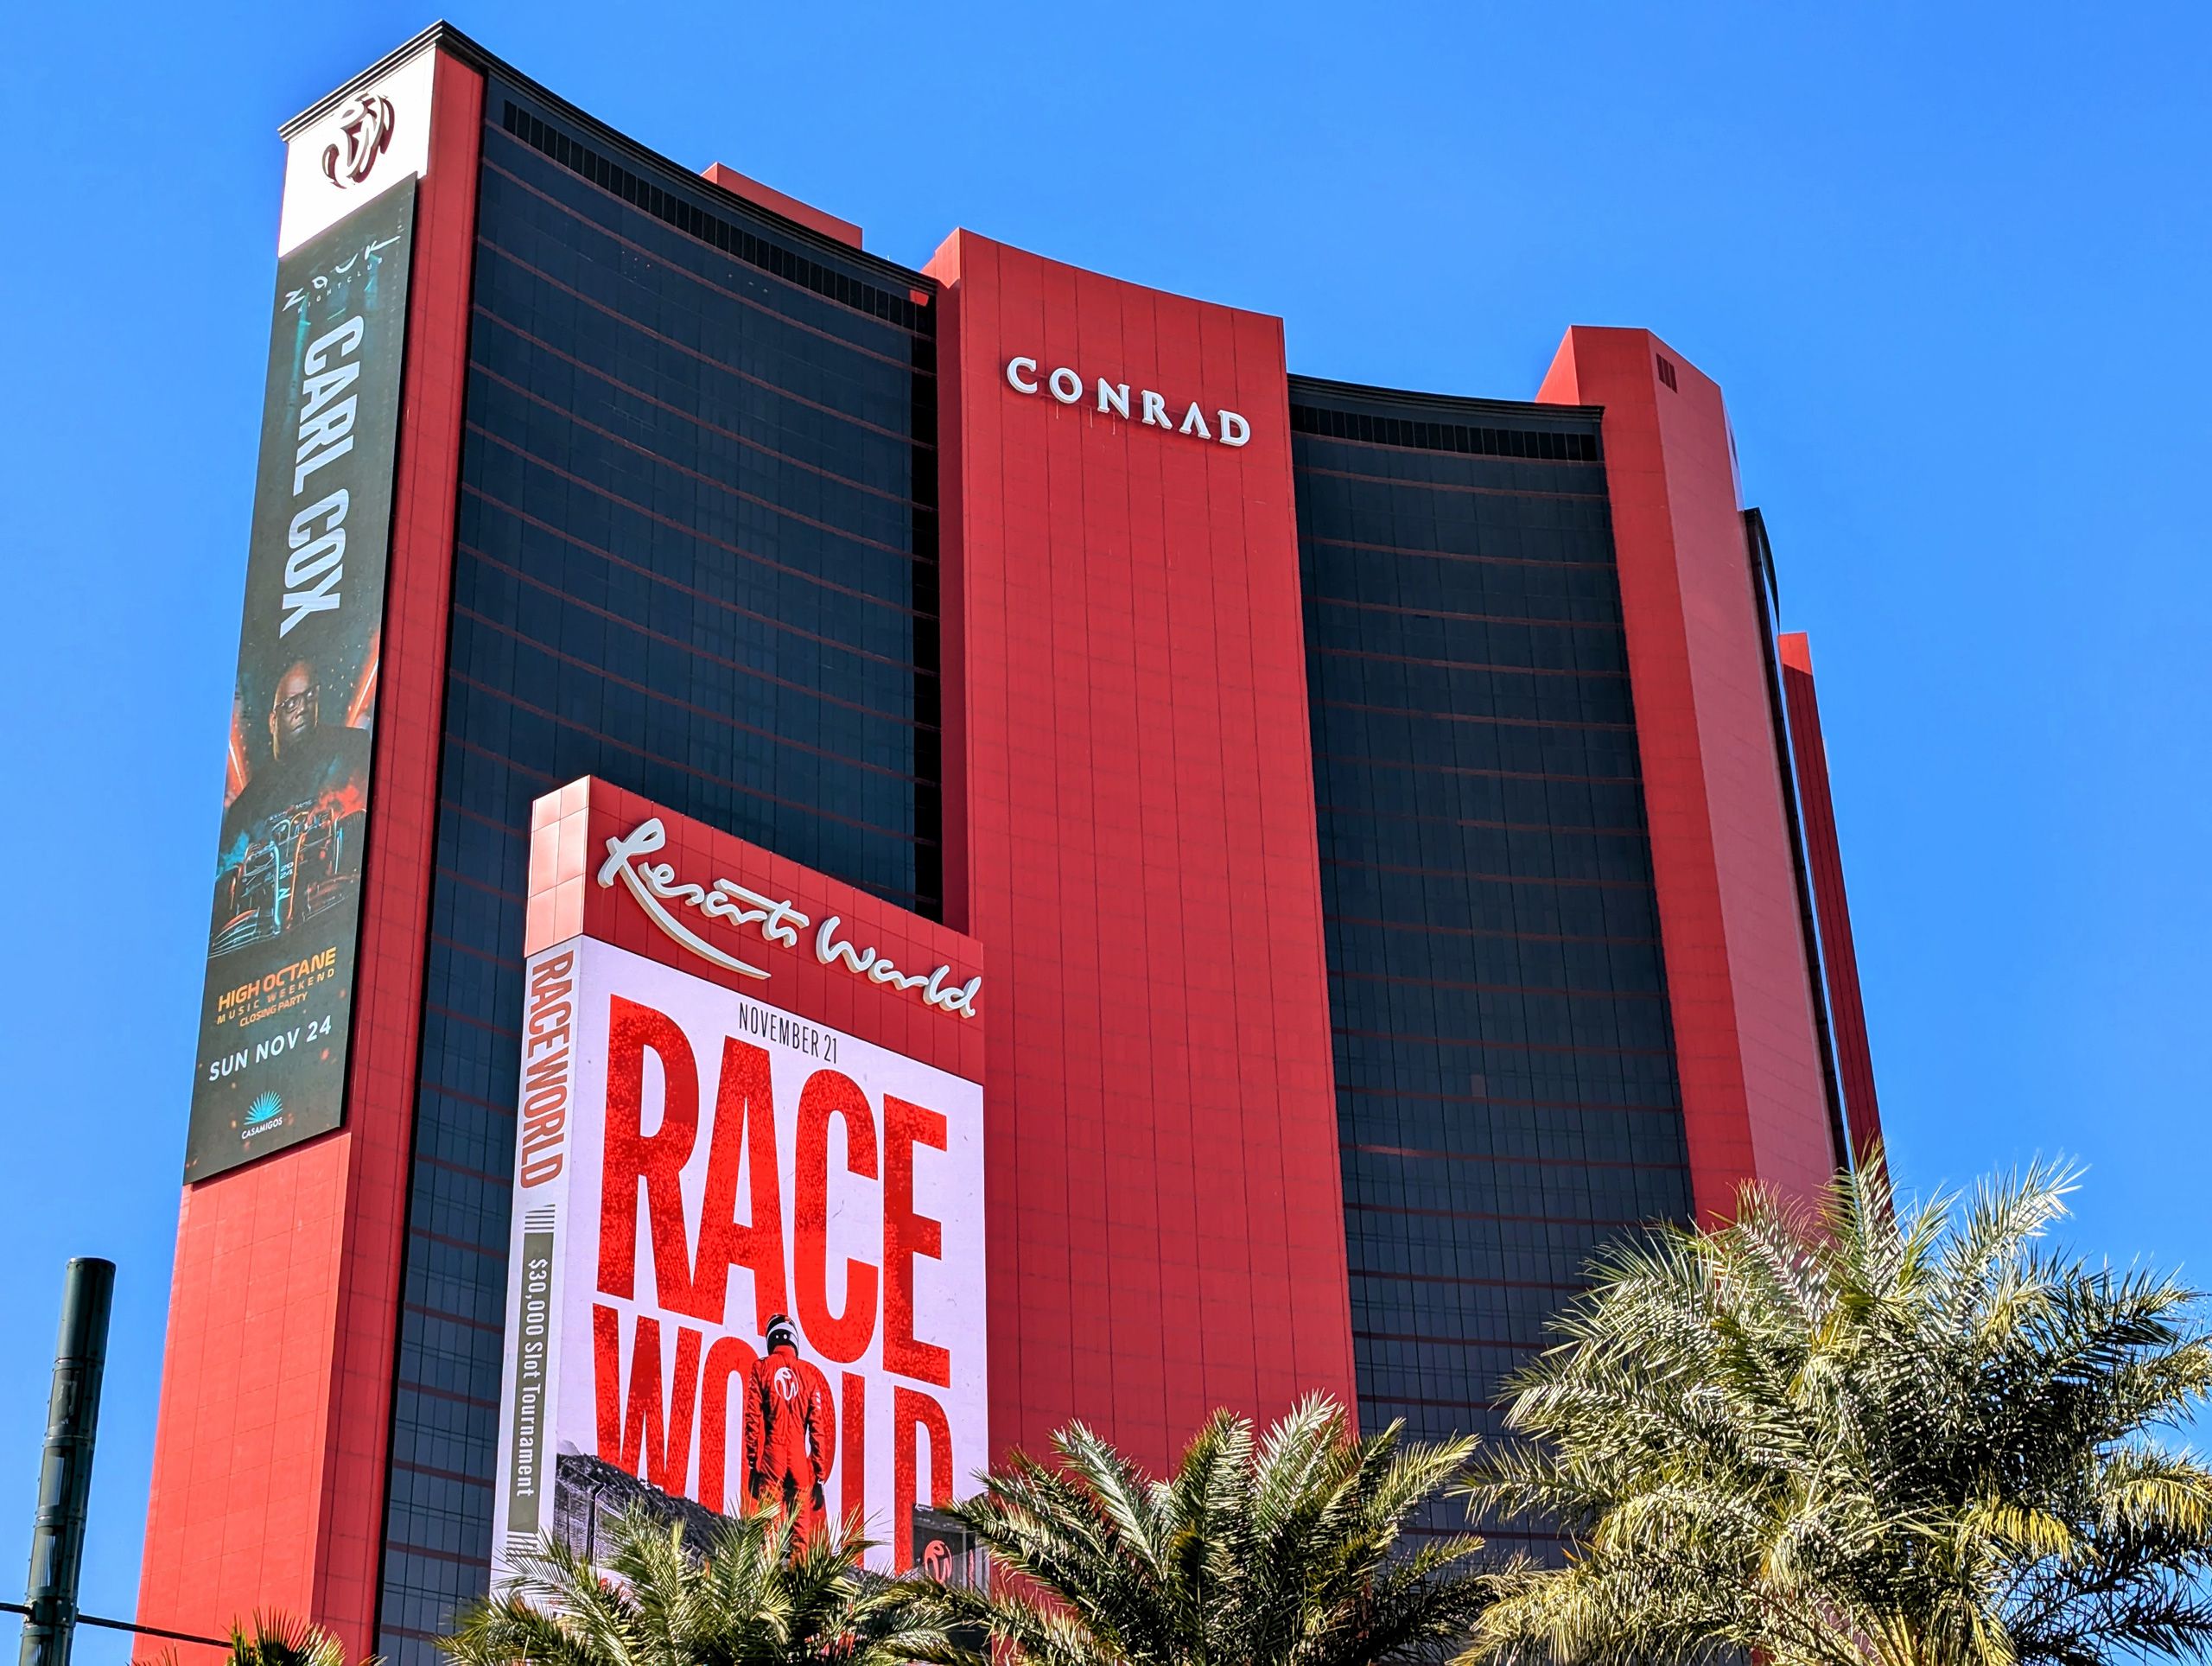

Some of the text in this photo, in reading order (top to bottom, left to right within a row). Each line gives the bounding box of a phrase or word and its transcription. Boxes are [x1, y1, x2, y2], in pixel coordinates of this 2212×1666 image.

[1006, 356, 1251, 448] CONRAD
[278, 315, 365, 639] CARL COX
[597, 817, 982, 1019] Resorts World
[216, 968, 334, 1025] MUSIC WEEKEND
[218, 946, 337, 1012] HIGH OCTANE
[239, 991, 308, 1027] CLOSING PARTY
[208, 1014, 332, 1082] SUN NOV 24
[739, 1002, 836, 1064] NOVEMBER 21
[241, 1116, 283, 1140] CASAMIGOS
[596, 994, 951, 1389] RACE
[517, 1258, 548, 1497] $30,000 Slot Tournament
